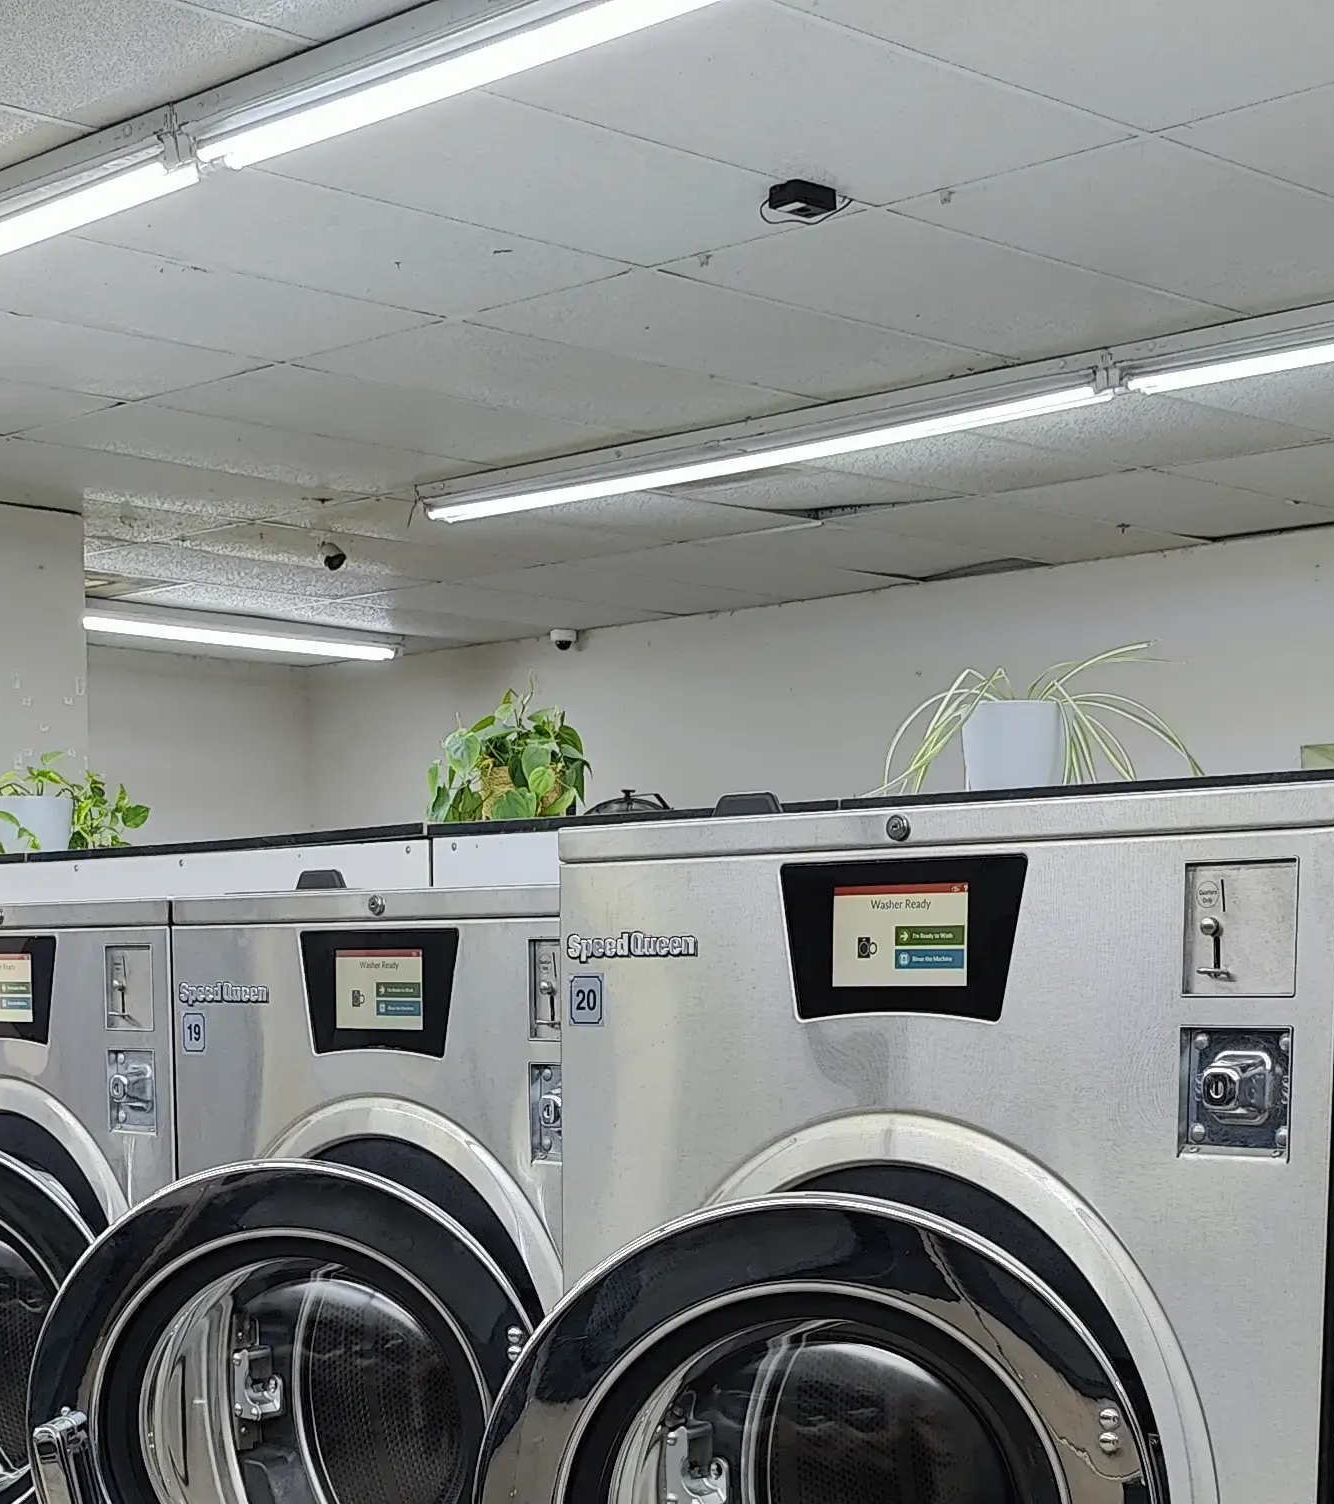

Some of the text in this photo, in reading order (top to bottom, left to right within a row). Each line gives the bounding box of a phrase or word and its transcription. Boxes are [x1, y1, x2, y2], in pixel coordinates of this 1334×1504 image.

[870, 898, 932, 910] Washer Ready
[567, 932, 631, 964] Speed
[630, 931, 698, 958] Queen
[178, 981, 269, 1007] Speed Queen
[575, 989, 597, 1011] 20
[187, 1024, 201, 1041] 19
